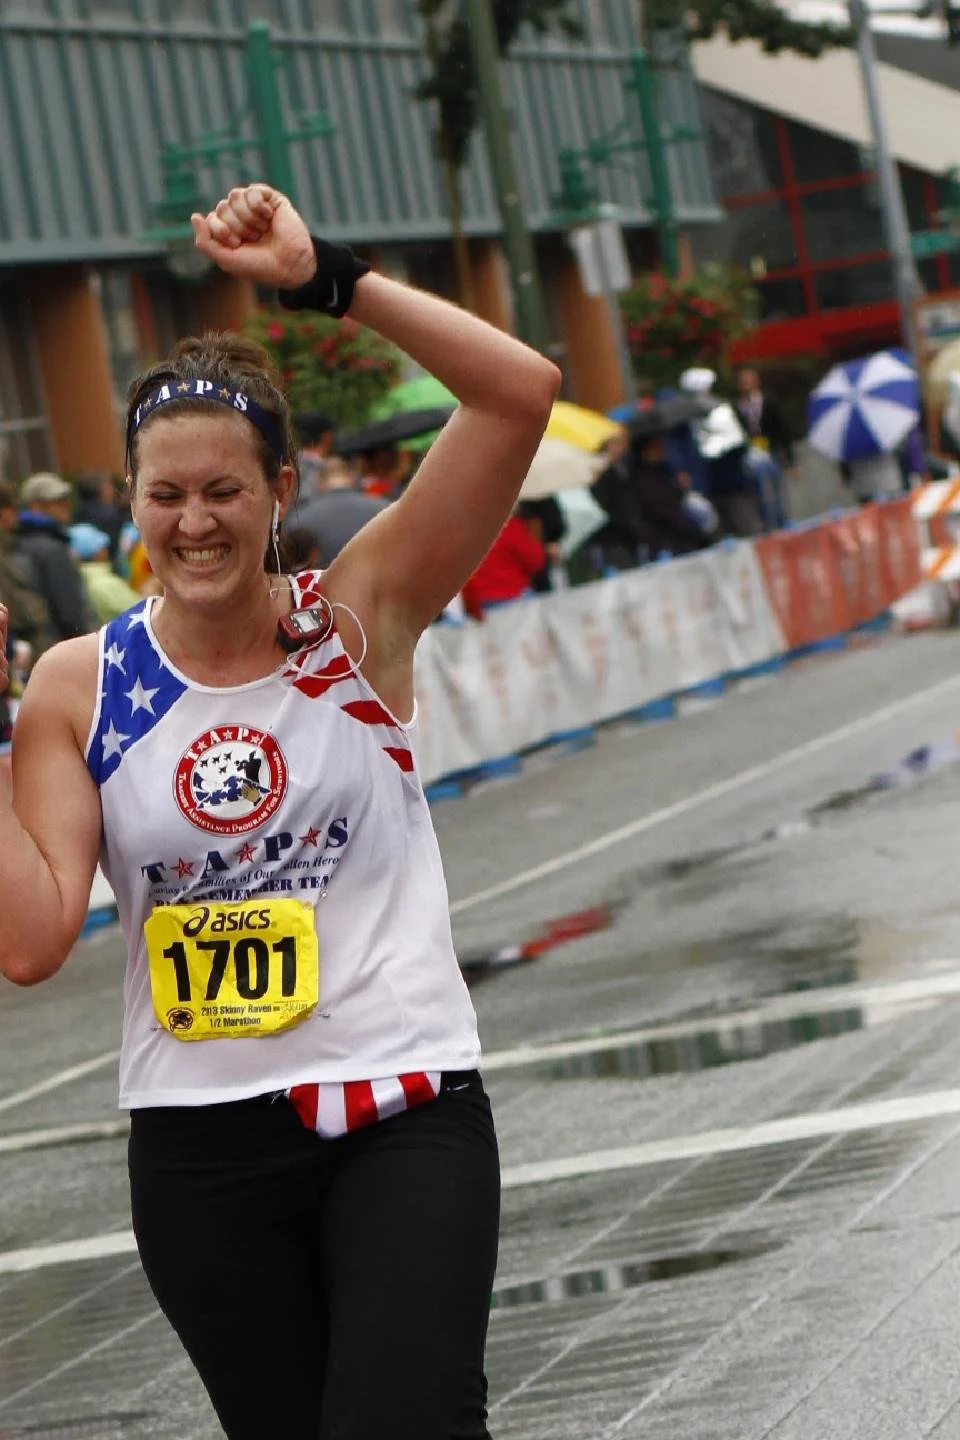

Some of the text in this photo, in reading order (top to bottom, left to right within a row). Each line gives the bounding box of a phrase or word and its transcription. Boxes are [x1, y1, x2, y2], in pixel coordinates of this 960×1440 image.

[283, 858, 310, 870] allen
[298, 875, 333, 891] TEA
[163, 936, 297, 1002] 1701
[220, 1005, 245, 1016] Skinny
[248, 1003, 272, 1013] Raven
[209, 1016, 261, 1028] 1/2 Marathon
